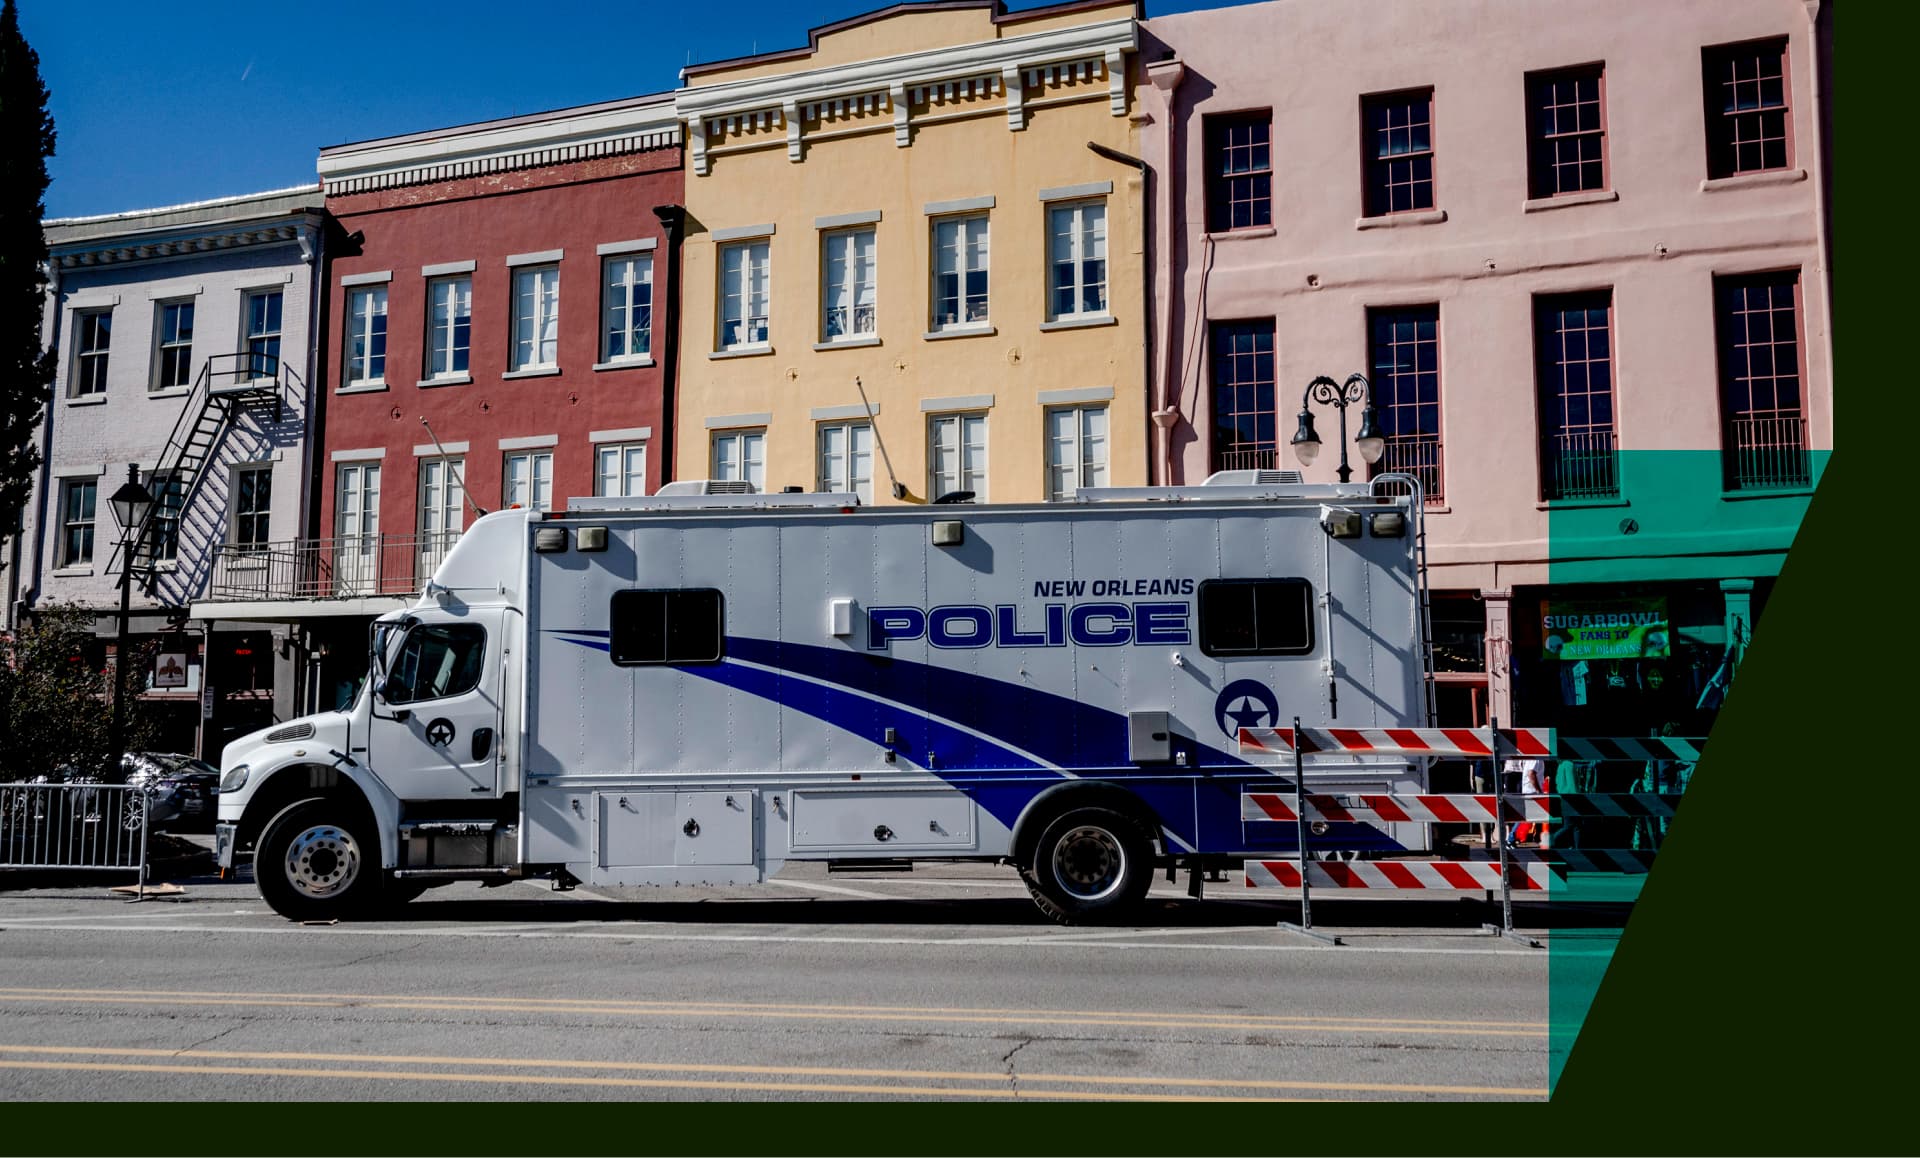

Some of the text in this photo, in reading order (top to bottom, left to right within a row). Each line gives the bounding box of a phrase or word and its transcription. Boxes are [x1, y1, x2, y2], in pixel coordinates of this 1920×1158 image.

[1034, 579, 1194, 597] NEW ORLEANS
[867, 602, 1192, 649] POLICE
[1545, 613, 1663, 629] SUGARBOWL
[1580, 630, 1629, 640] FANS TO
[1570, 643, 1642, 655] NEW ORLEANS
